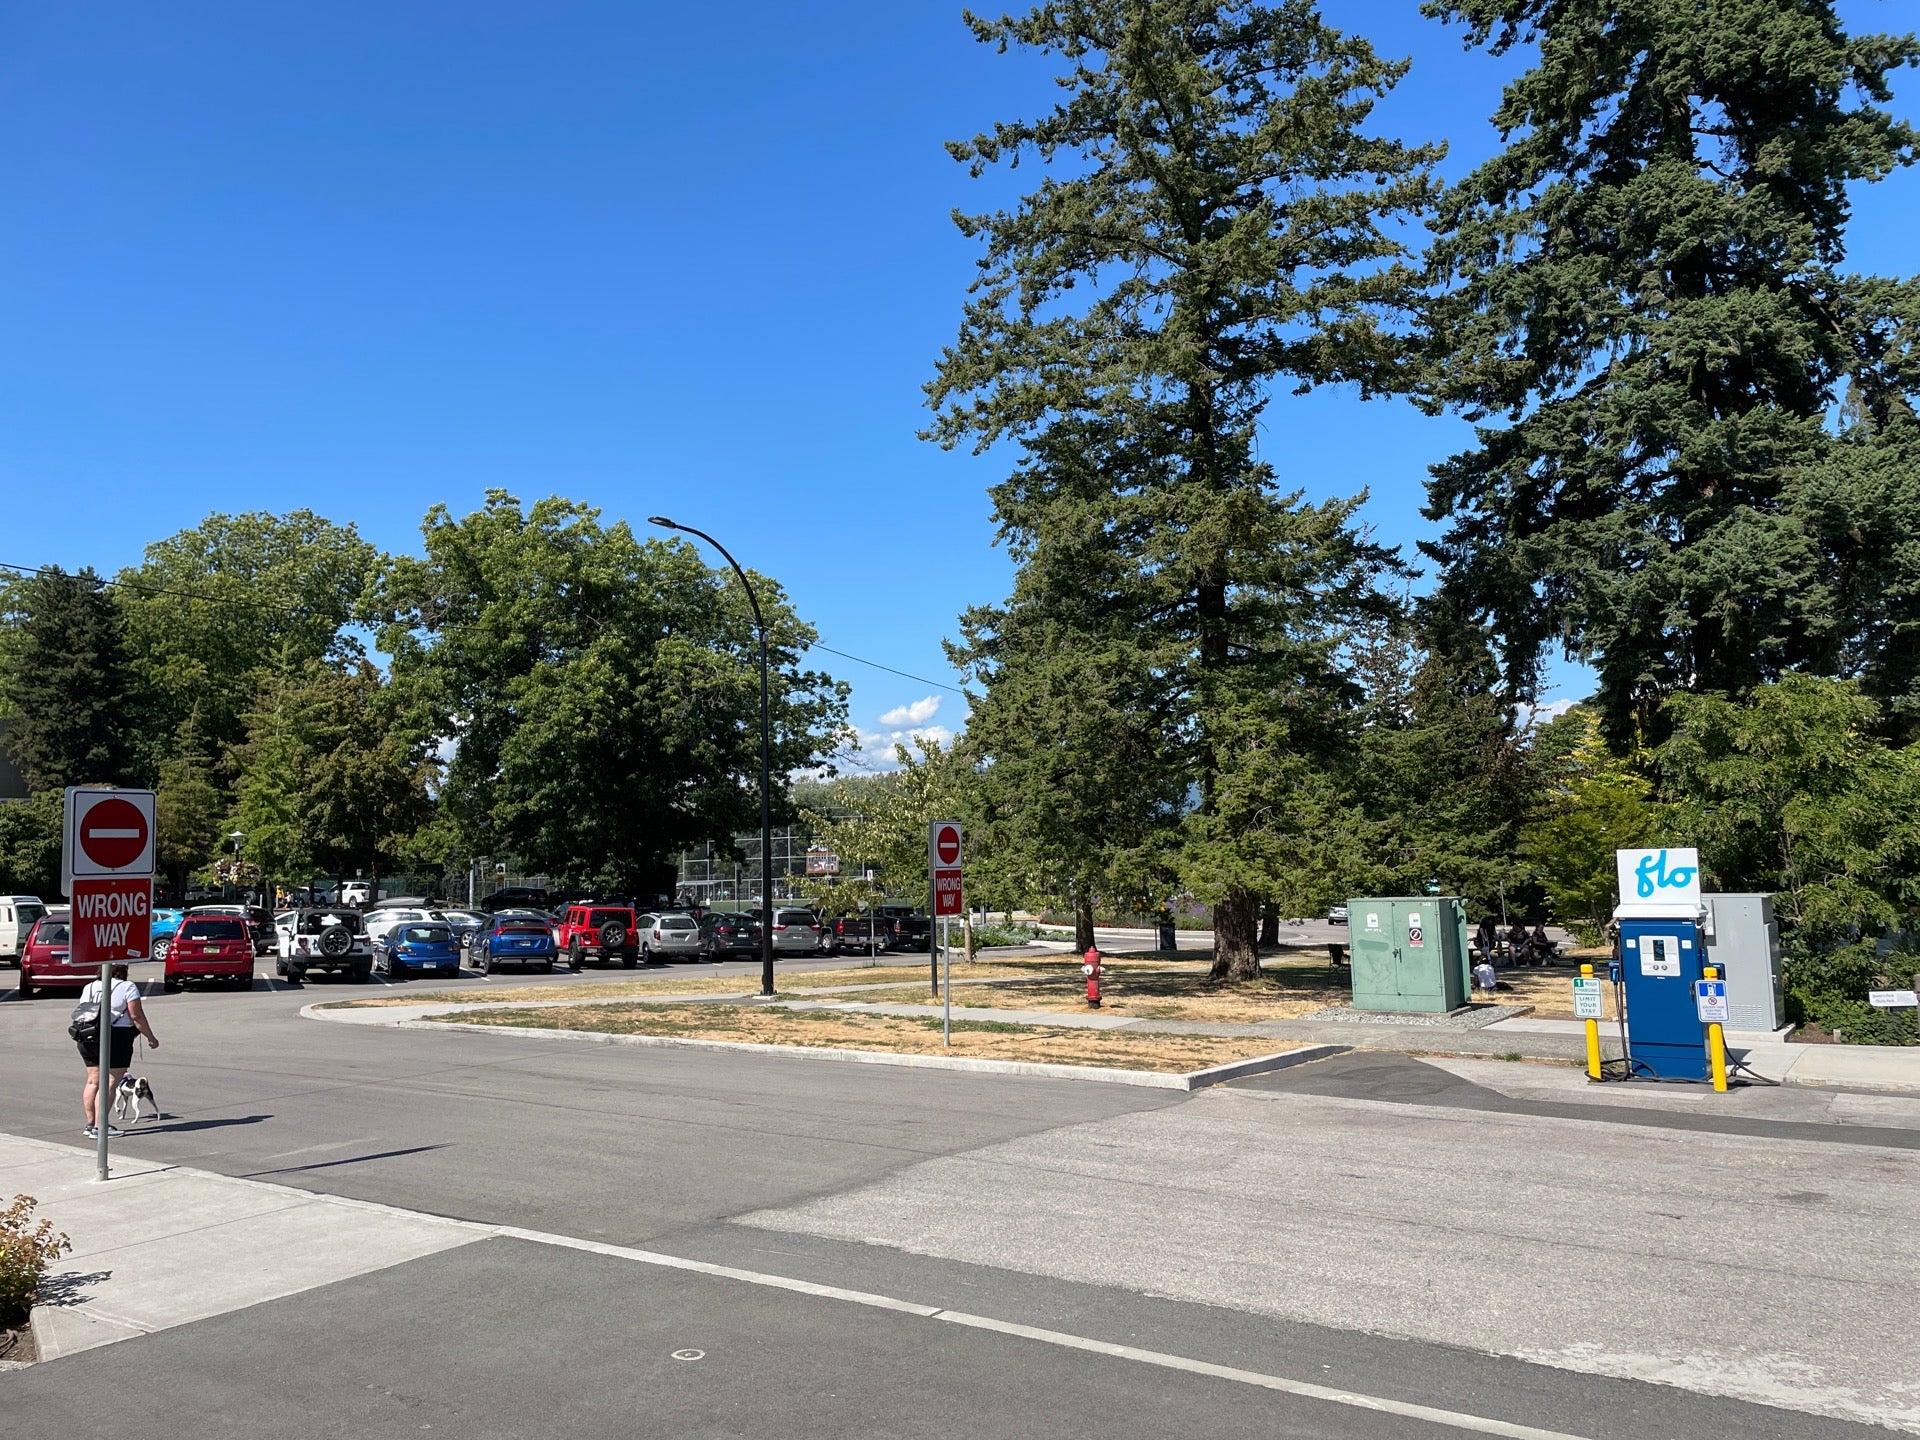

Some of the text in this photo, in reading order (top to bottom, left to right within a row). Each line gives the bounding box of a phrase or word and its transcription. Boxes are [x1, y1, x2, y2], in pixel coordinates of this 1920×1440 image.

[937, 877, 961, 891] WRONG
[1635, 850, 1697, 897] flo
[77, 892, 147, 918] WRONG
[942, 894, 955, 907] WAY
[93, 923, 130, 947] WAY
